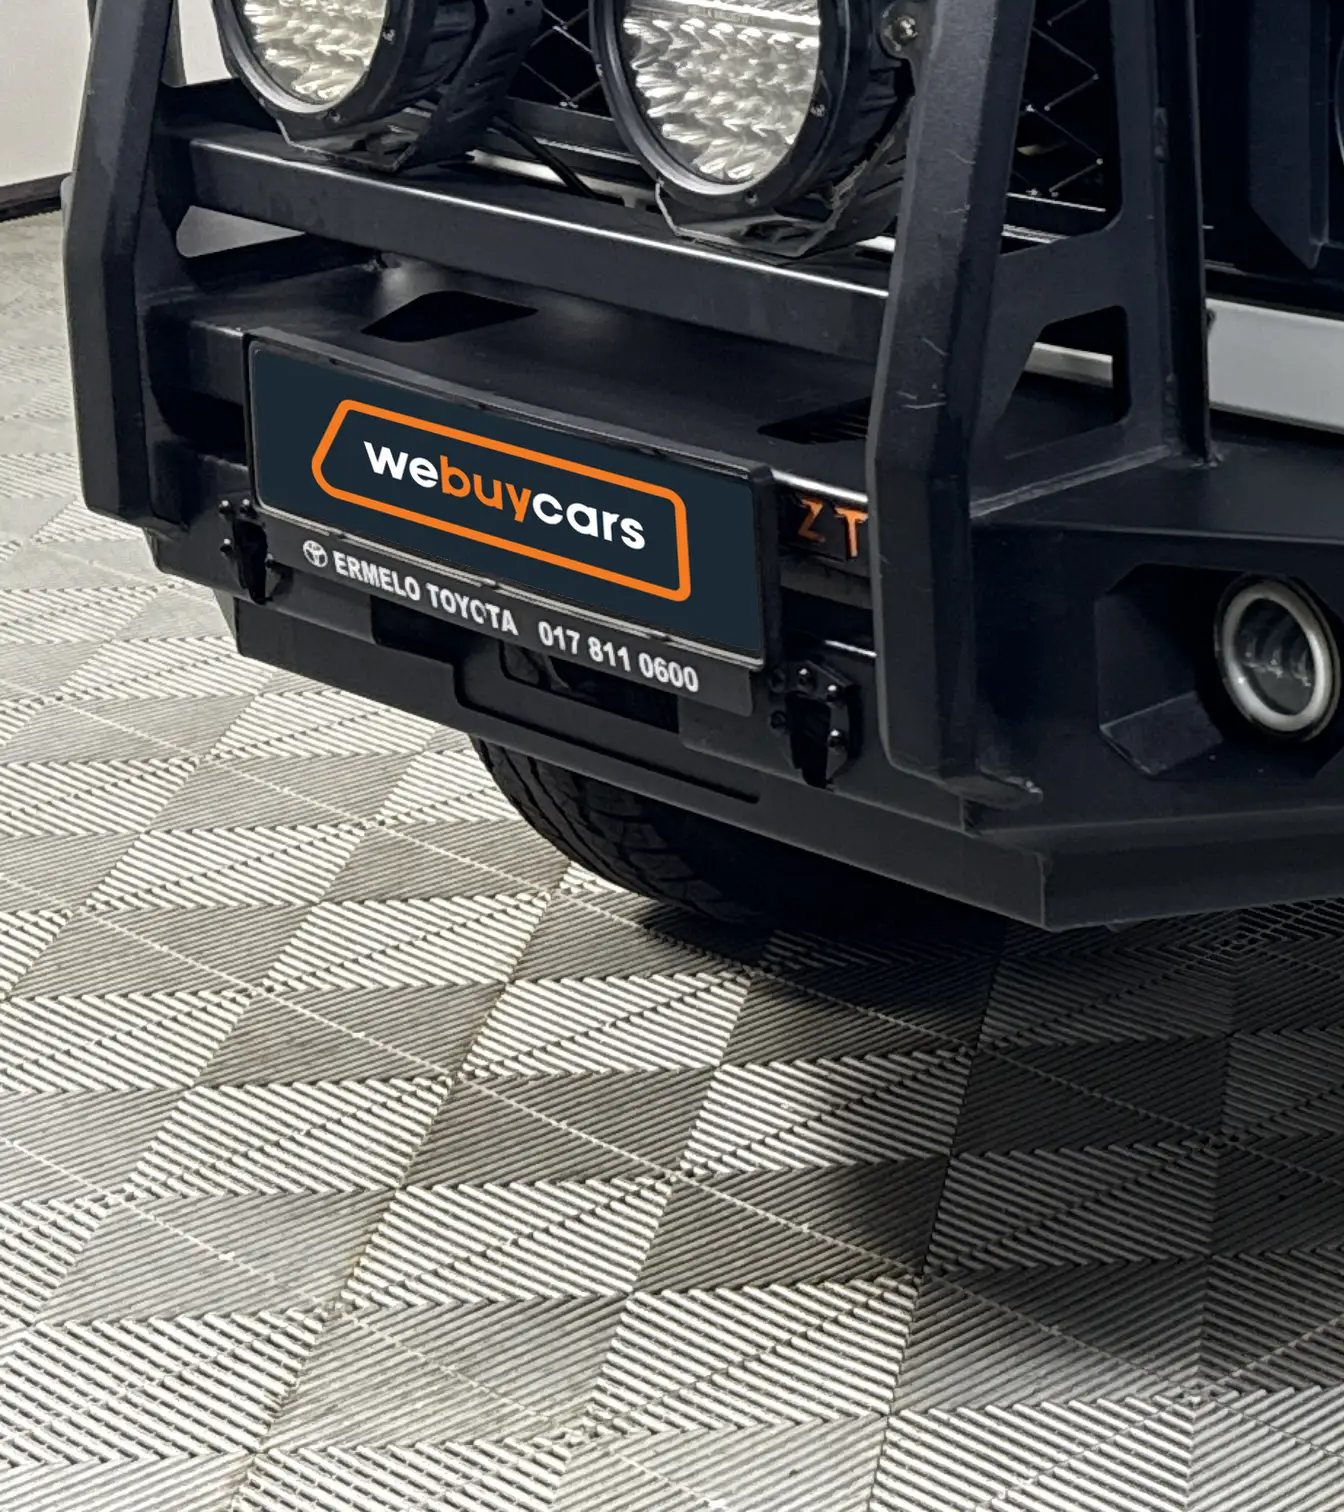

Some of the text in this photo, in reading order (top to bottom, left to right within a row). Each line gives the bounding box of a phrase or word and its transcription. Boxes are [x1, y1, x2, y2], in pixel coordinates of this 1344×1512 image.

[333, 551, 699, 693] ERMELO TOYOTA 017 811 0600
